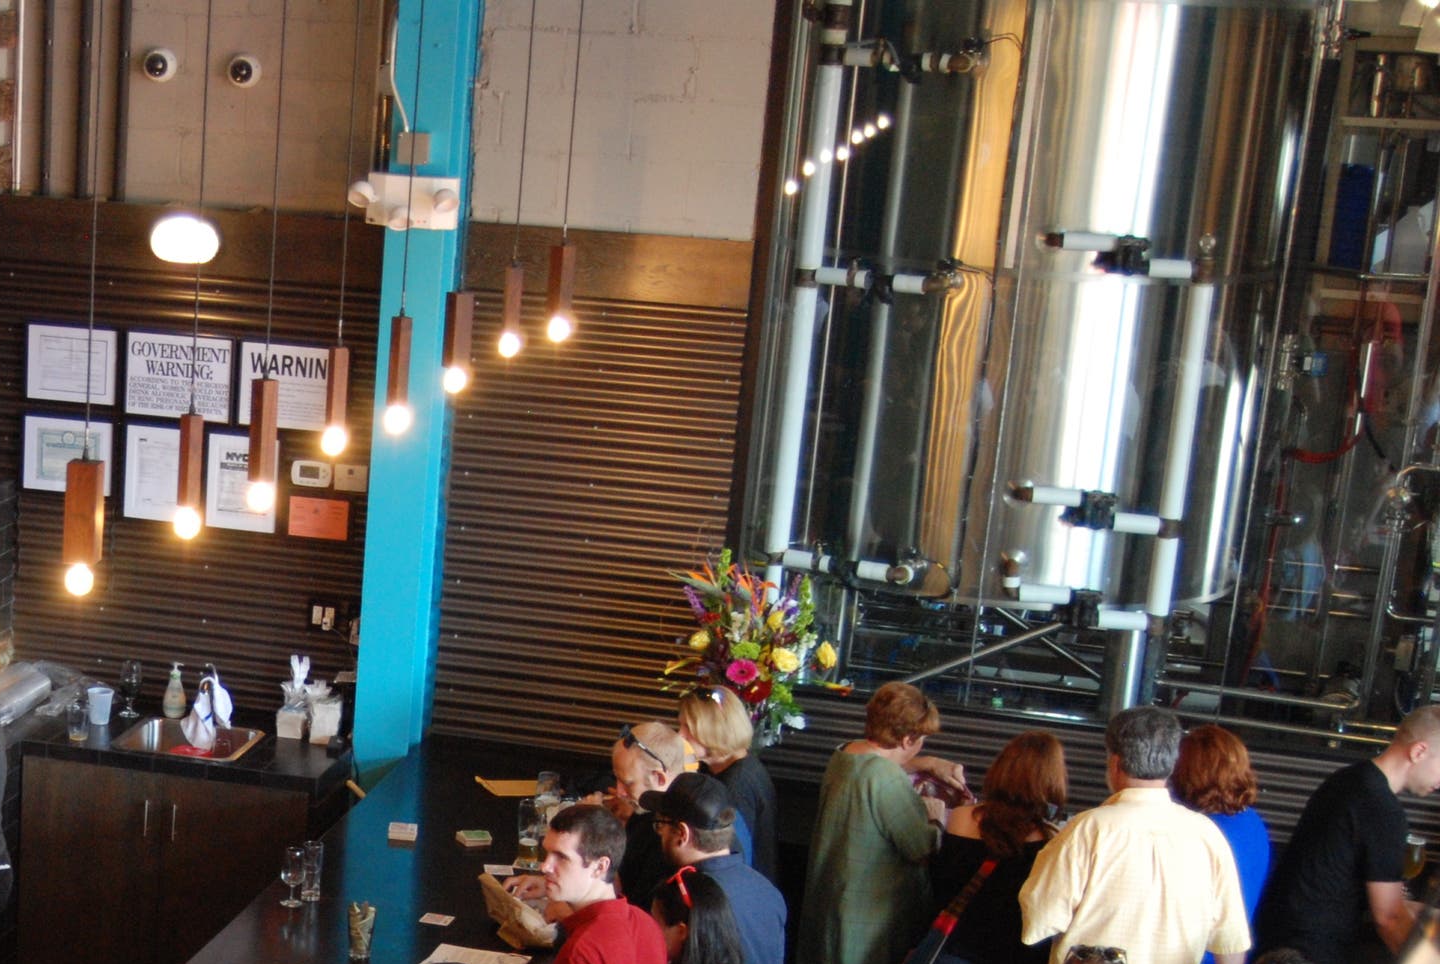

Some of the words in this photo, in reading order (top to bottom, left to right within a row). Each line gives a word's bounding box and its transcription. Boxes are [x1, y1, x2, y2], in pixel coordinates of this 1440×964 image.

[131, 340, 230, 364] GOVERNMENT
[146, 359, 214, 381] WARNING:
[251, 352, 328, 380] WARNIN
